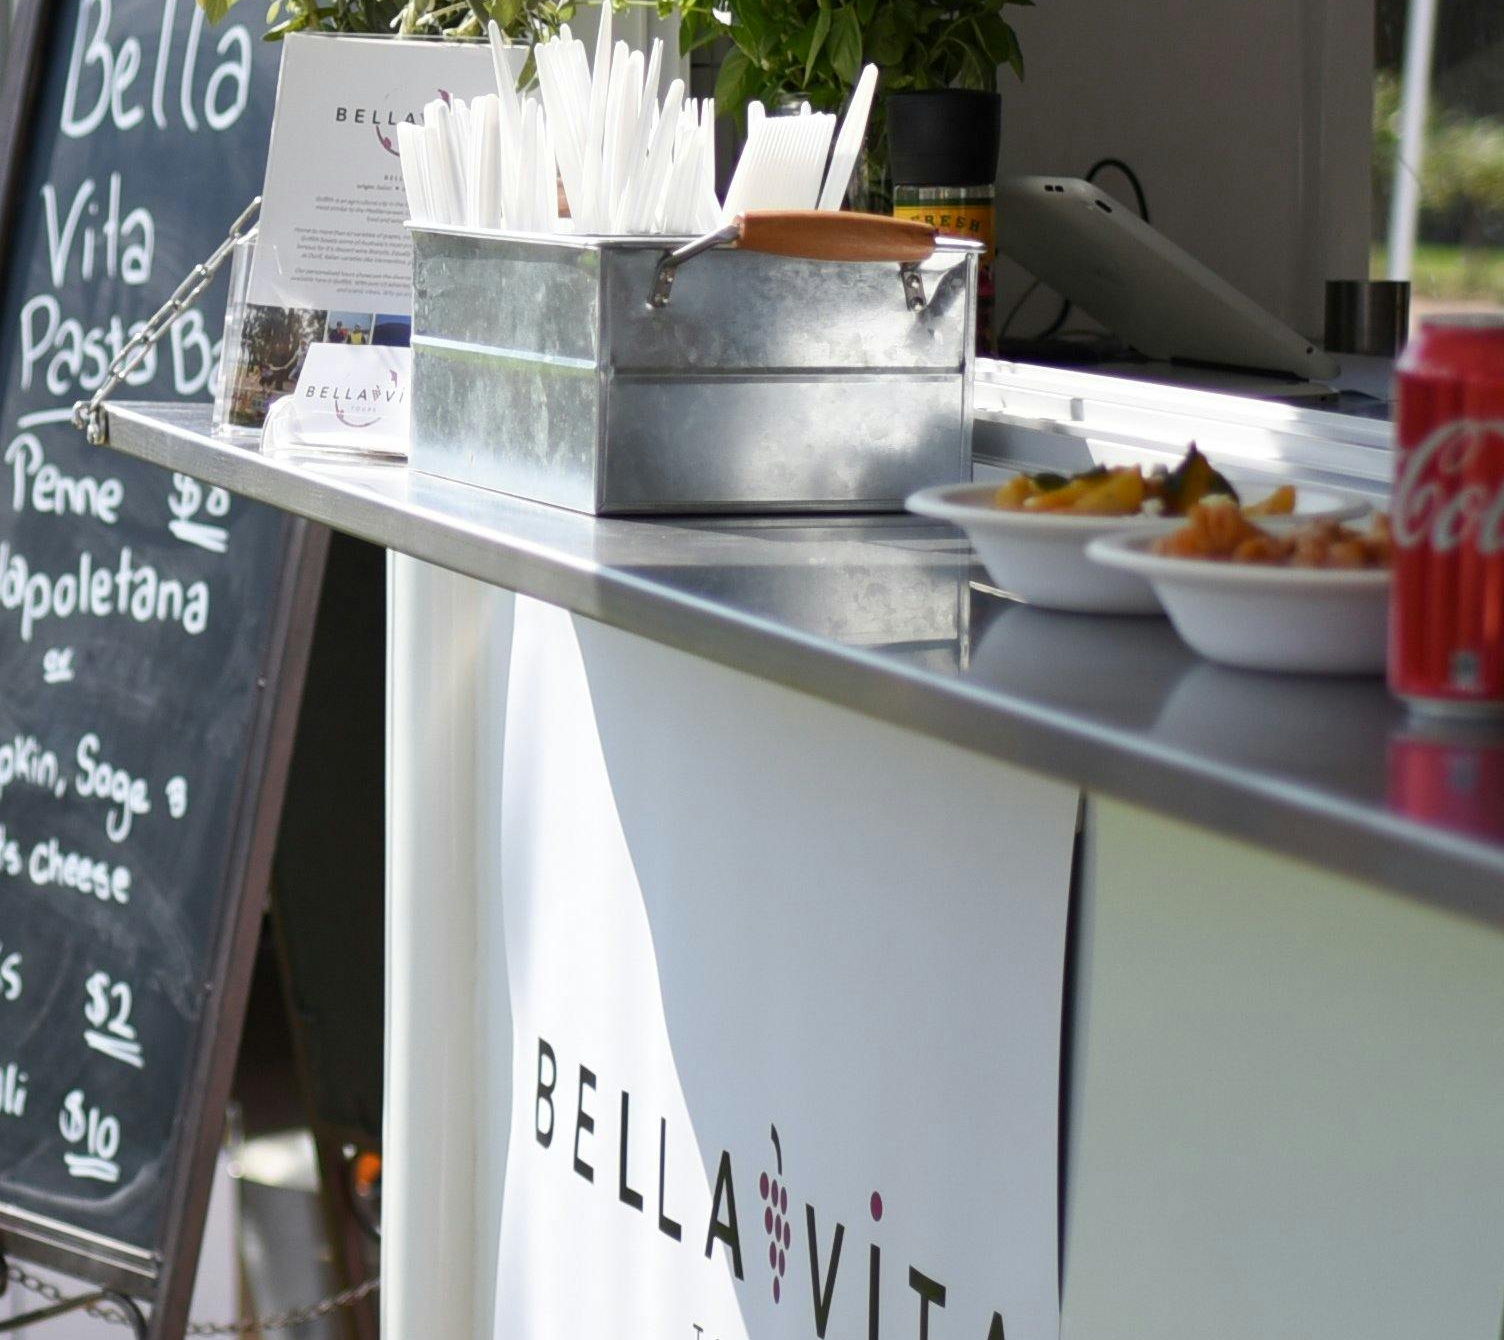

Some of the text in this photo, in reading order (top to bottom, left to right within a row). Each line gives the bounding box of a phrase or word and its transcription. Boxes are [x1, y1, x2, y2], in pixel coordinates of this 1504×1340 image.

[336, 106, 416, 125] BELLA
[41, 171, 155, 288] Vita
[20, 294, 158, 396] Pasta
[305, 385, 367, 401] BELLA
[4, 432, 125, 524] Penne
[84, 970, 137, 1040] $2
[58, 1088, 120, 1160] $10
[535, 1036, 744, 1282] BELLA
